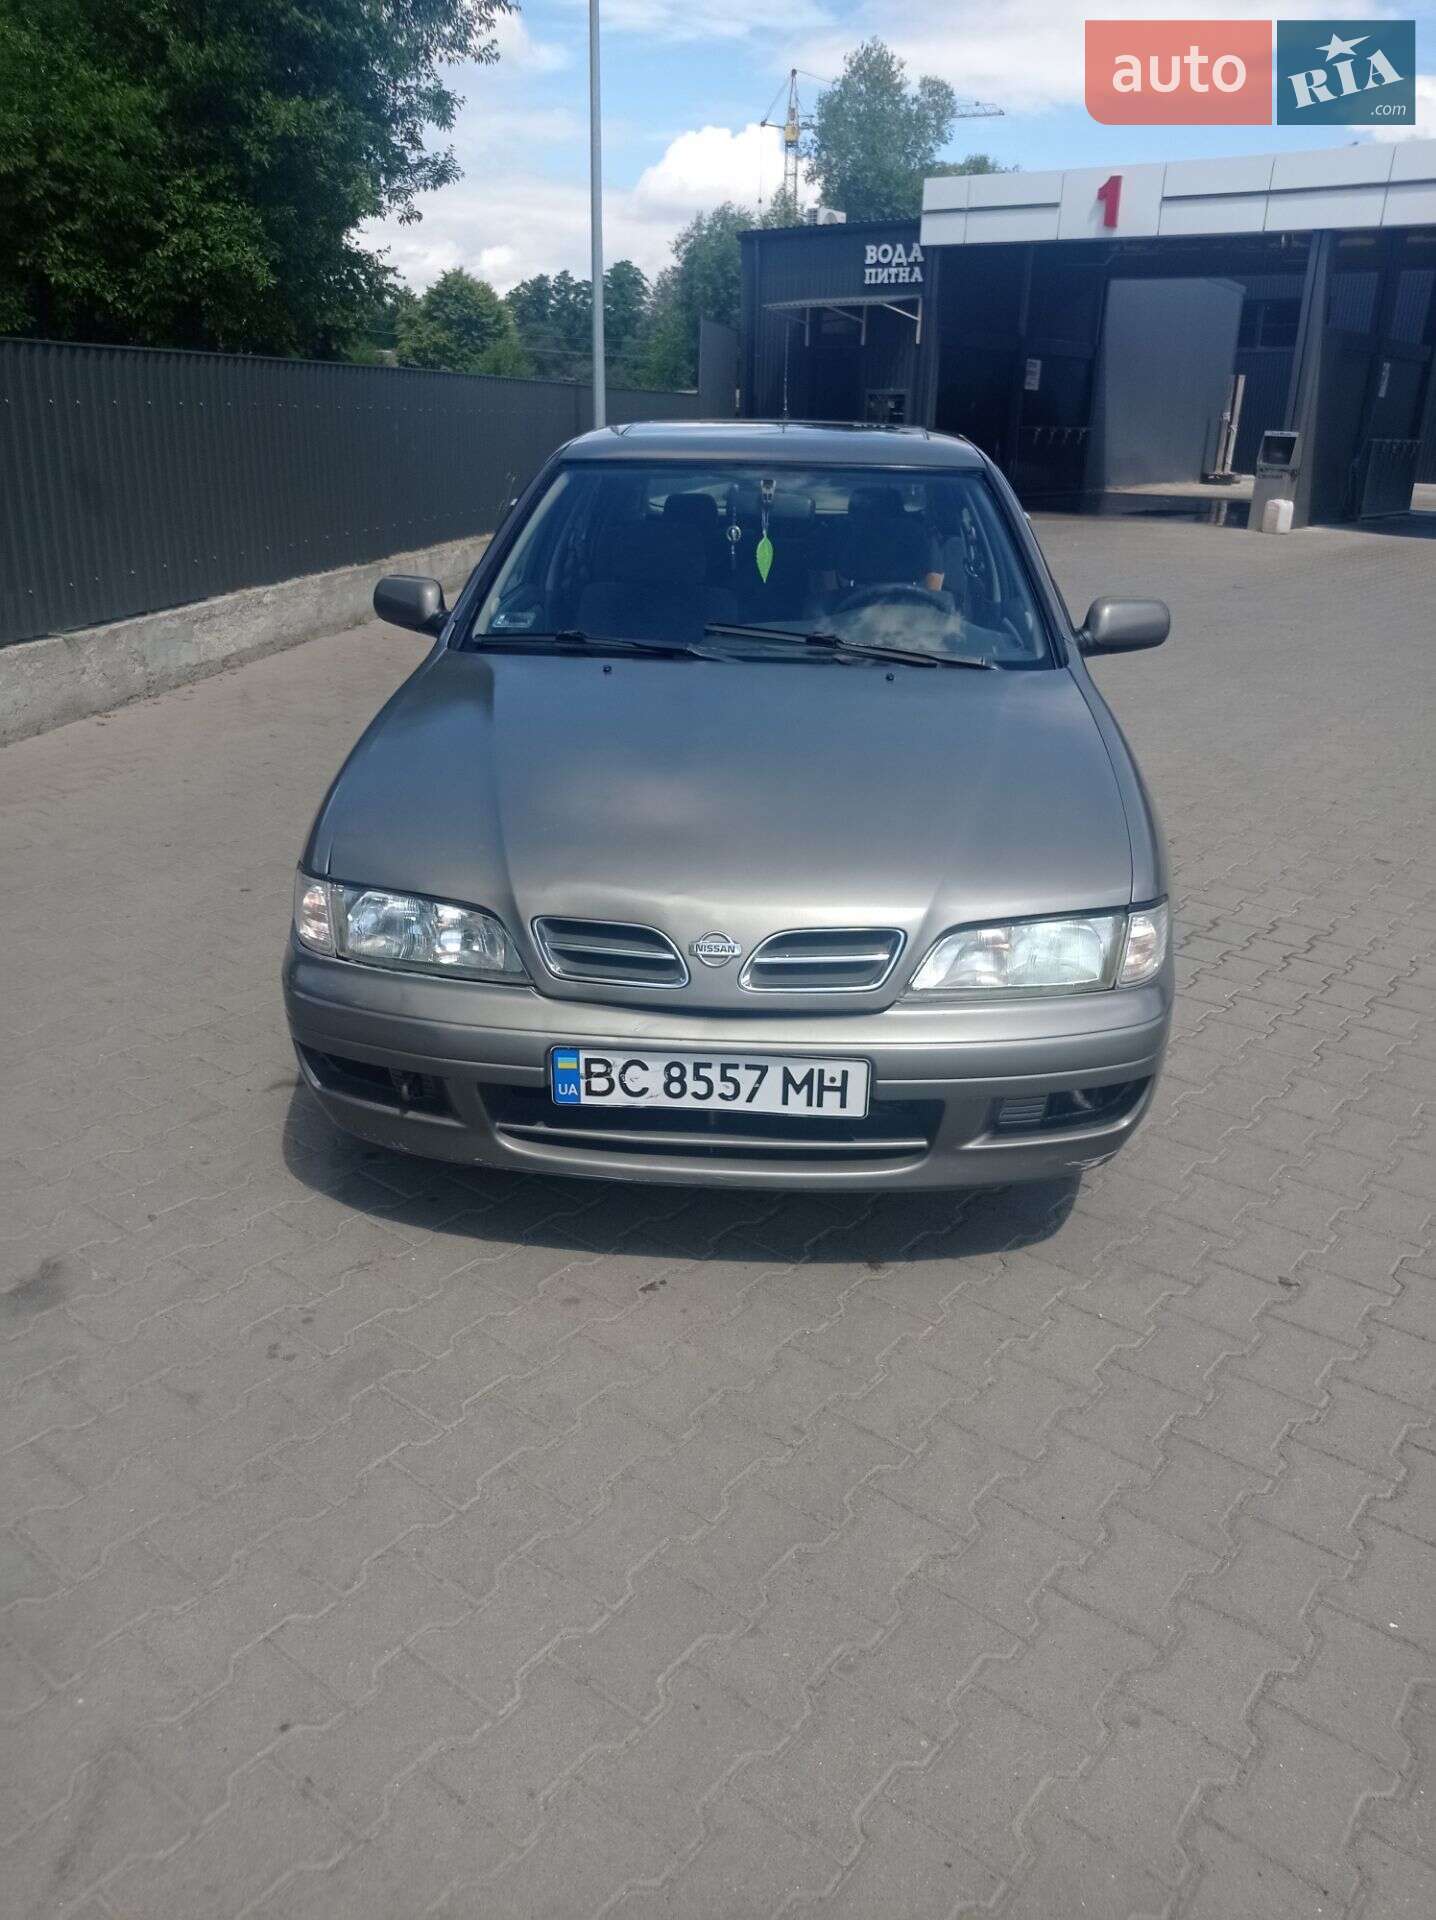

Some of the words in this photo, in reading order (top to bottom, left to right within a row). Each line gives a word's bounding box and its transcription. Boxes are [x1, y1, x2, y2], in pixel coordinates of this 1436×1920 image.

[1097, 175, 1122, 228] 1
[864, 243, 925, 266] ВОДА
[864, 266, 924, 284] ПИТНА
[695, 943, 736, 953] NISSAN
[558, 1083, 578, 1095] UA
[584, 1057, 650, 1098] BC
[663, 1061, 769, 1103] 8557
[781, 1066, 849, 1109] MH
